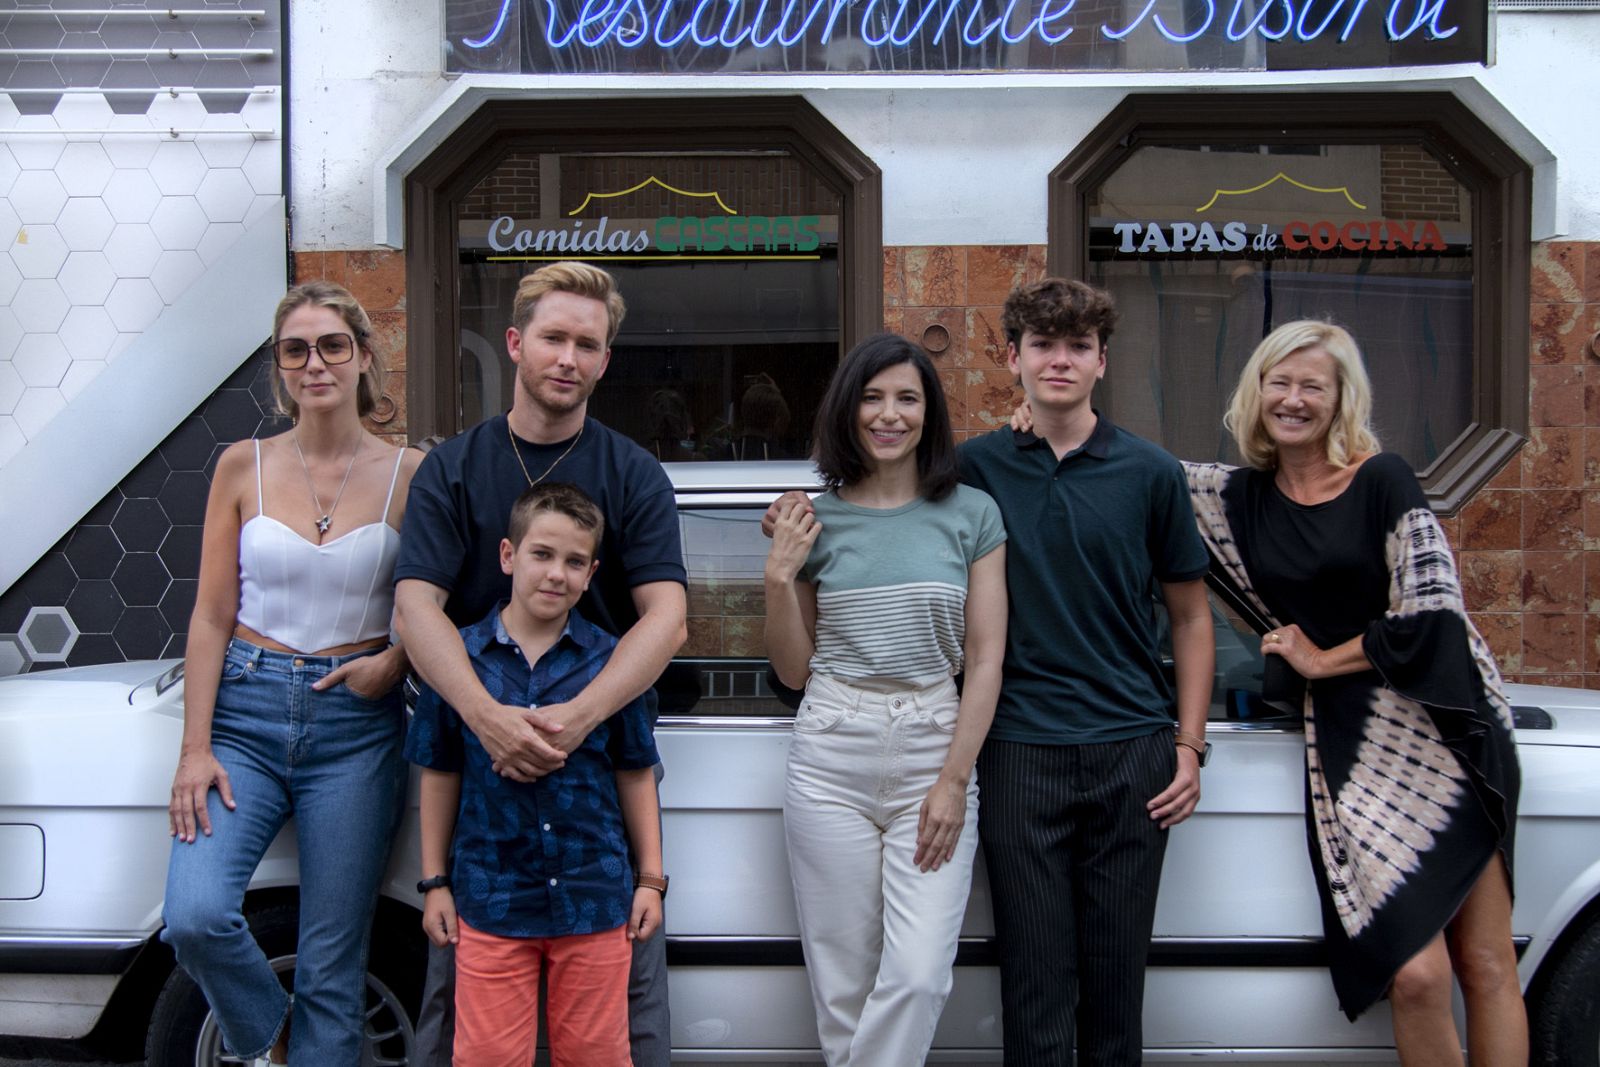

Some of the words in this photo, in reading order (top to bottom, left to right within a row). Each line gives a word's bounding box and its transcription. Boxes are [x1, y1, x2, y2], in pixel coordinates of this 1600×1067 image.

[487, 215, 650, 252] Comidas
[654, 215, 821, 252] CASERAS
[1113, 221, 1248, 253] TAPAS
[1251, 223, 1278, 251] de
[1281, 220, 1448, 251] COCINA
